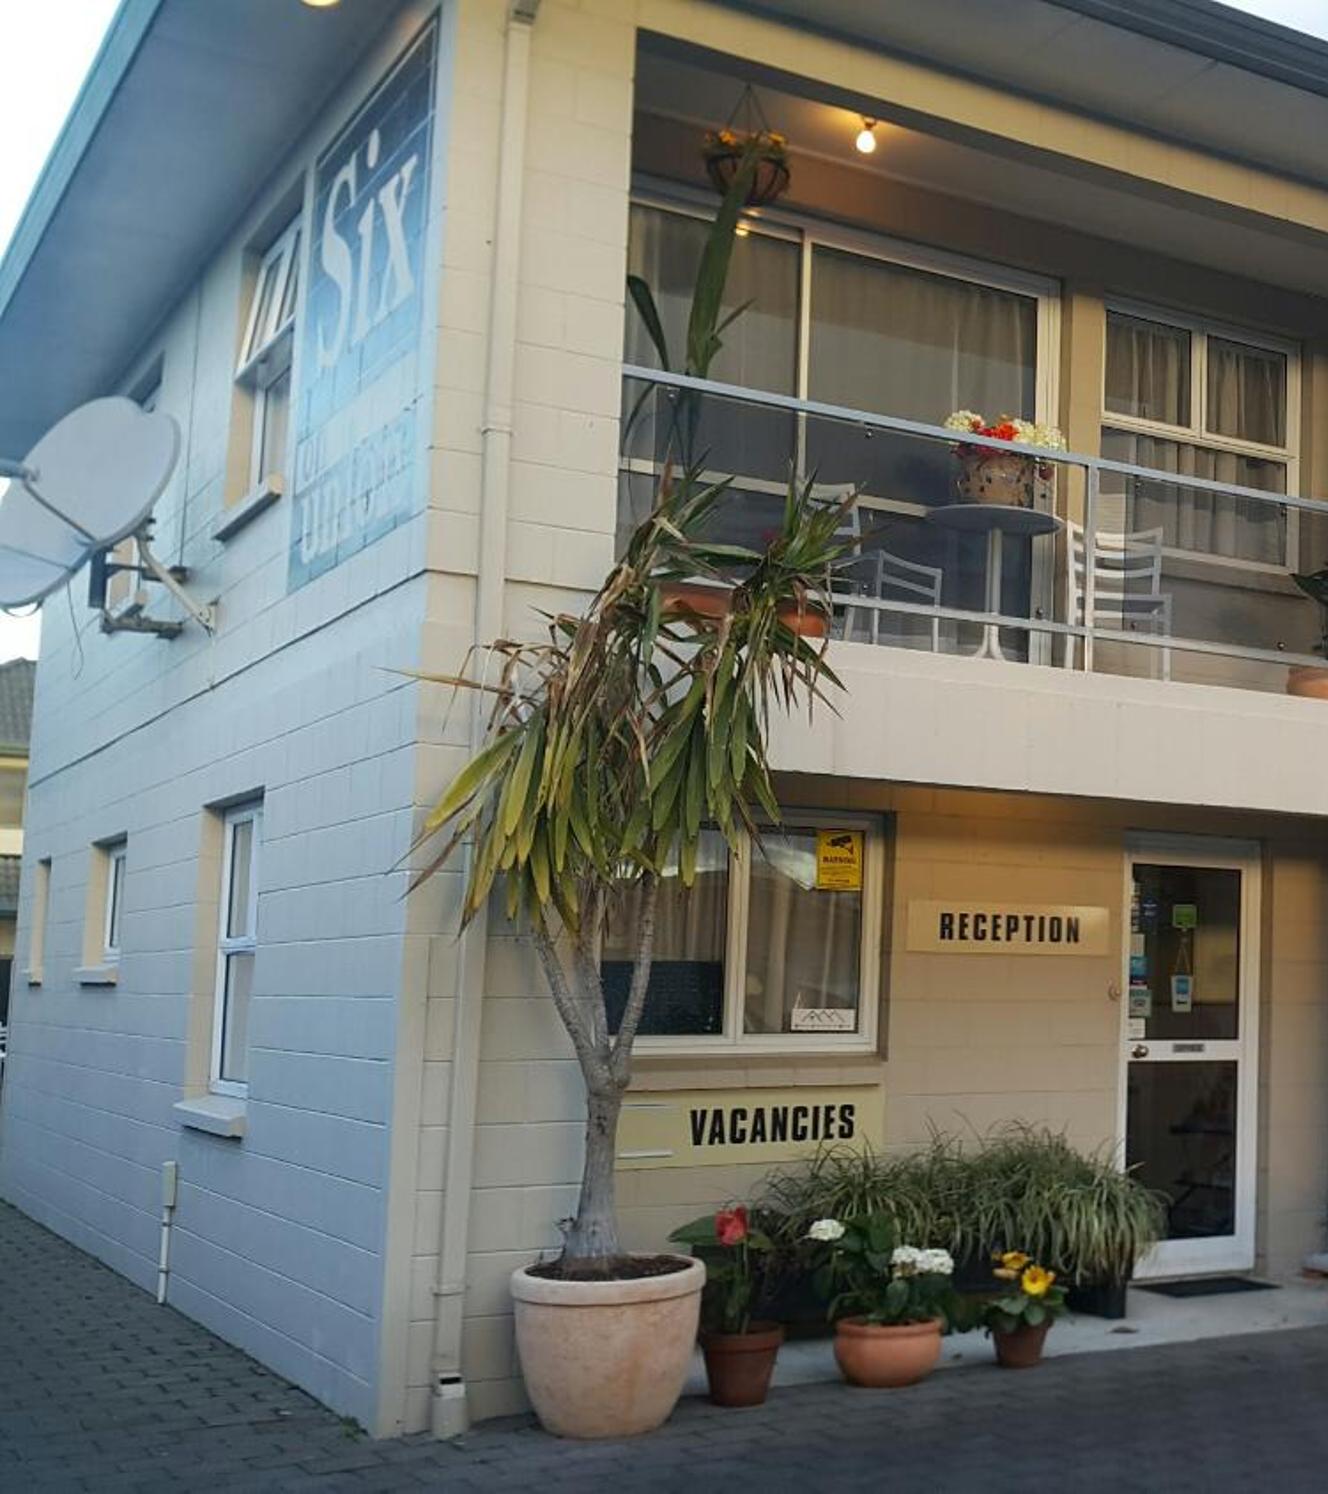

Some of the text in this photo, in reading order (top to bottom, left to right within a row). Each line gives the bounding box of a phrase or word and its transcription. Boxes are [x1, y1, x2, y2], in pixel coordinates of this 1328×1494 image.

[318, 128, 418, 368] Six
[939, 912, 1080, 943] RECEPTION
[690, 1103, 855, 1146] VACANCIES
